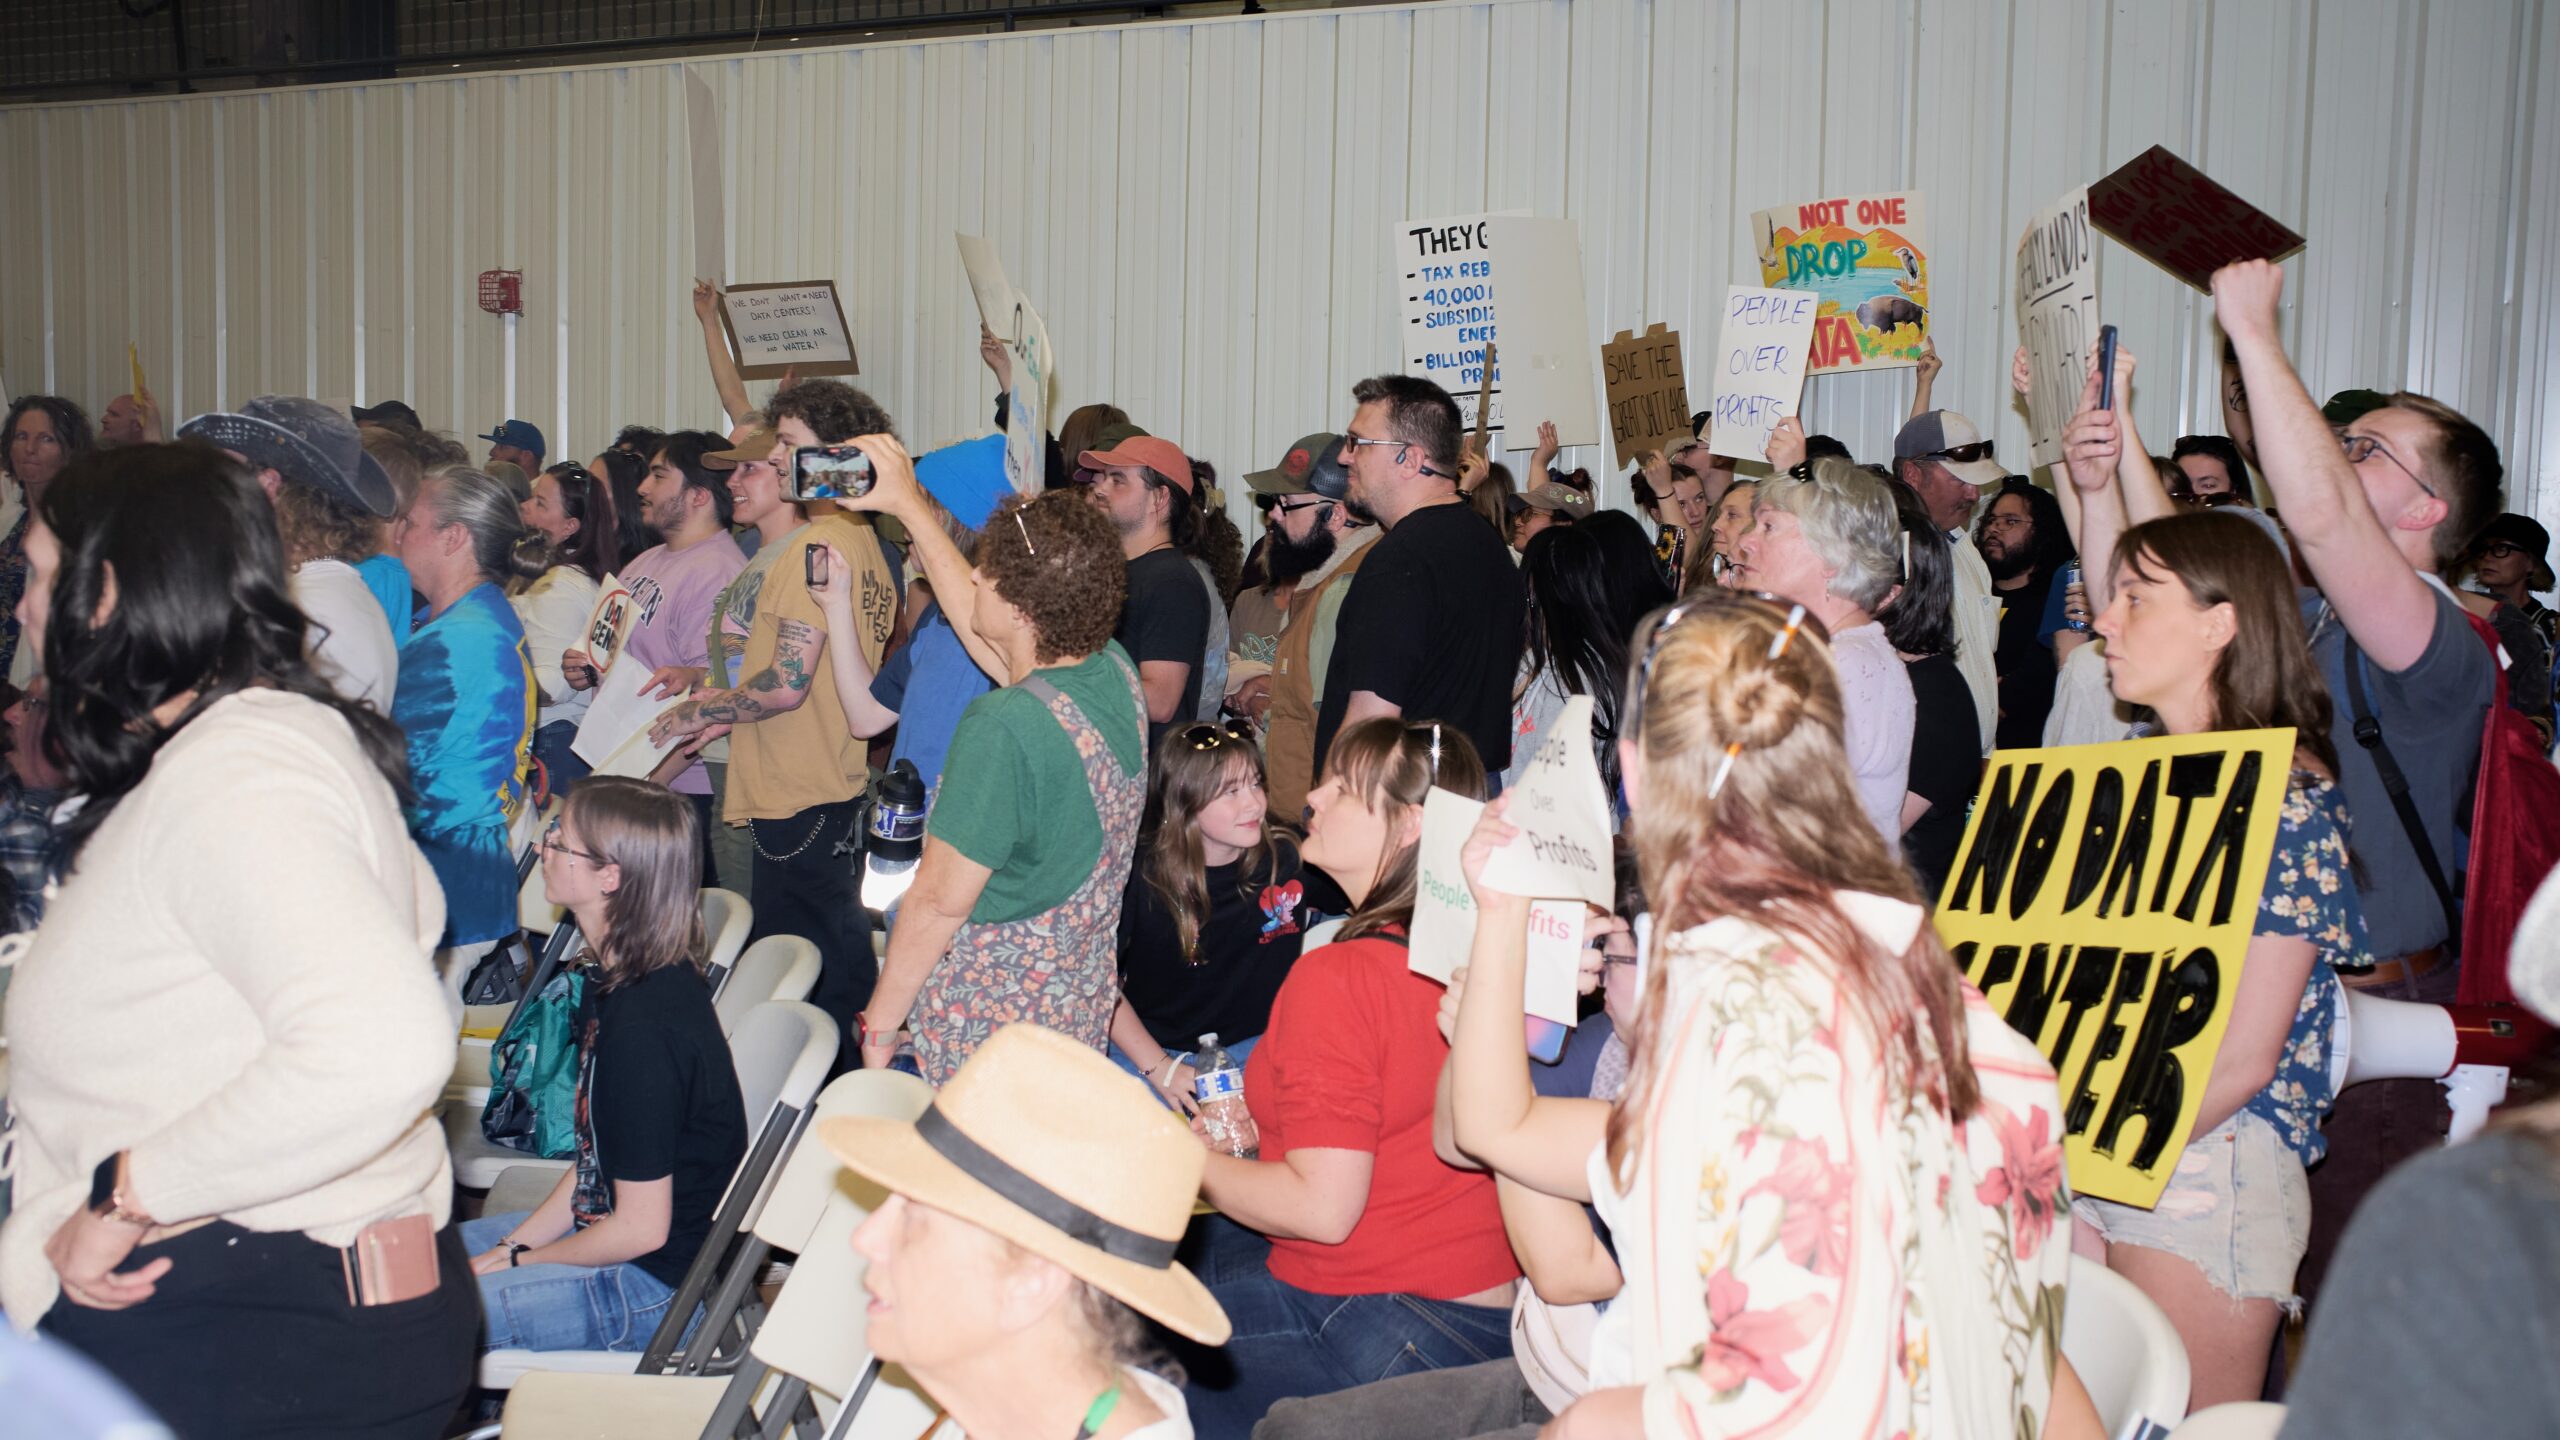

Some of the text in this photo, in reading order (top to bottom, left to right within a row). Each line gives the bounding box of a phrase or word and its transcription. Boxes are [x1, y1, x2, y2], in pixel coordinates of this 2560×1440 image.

[1799, 198, 1906, 231] NOT ONE
[1409, 224, 1472, 256] THEY
[1421, 260, 1490, 282] TAX REB
[1785, 239, 1867, 284] DROP
[732, 298, 747, 308] WE
[779, 293, 800, 303] WANT
[808, 290, 829, 300] NEED
[1423, 284, 1485, 307] 40,000
[1731, 294, 1812, 328] PEOPLE
[750, 306, 816, 321] DATA CENTERS!
[743, 327, 828, 344] WE NEED CLEAN AIR
[783, 341, 818, 352] WATER!
[1426, 348, 1499, 370] BILLION
[1607, 344, 1680, 385] SAVE THE
[1729, 345, 1788, 375] OVER
[1611, 387, 1691, 443] GREAT SALT LAKE
[1716, 393, 1783, 431] PROFITS
[1527, 829, 1598, 872] Profits
[1948, 750, 2264, 928] NO DATA
[1424, 869, 1470, 911] People
[1530, 907, 1570, 940] fits
